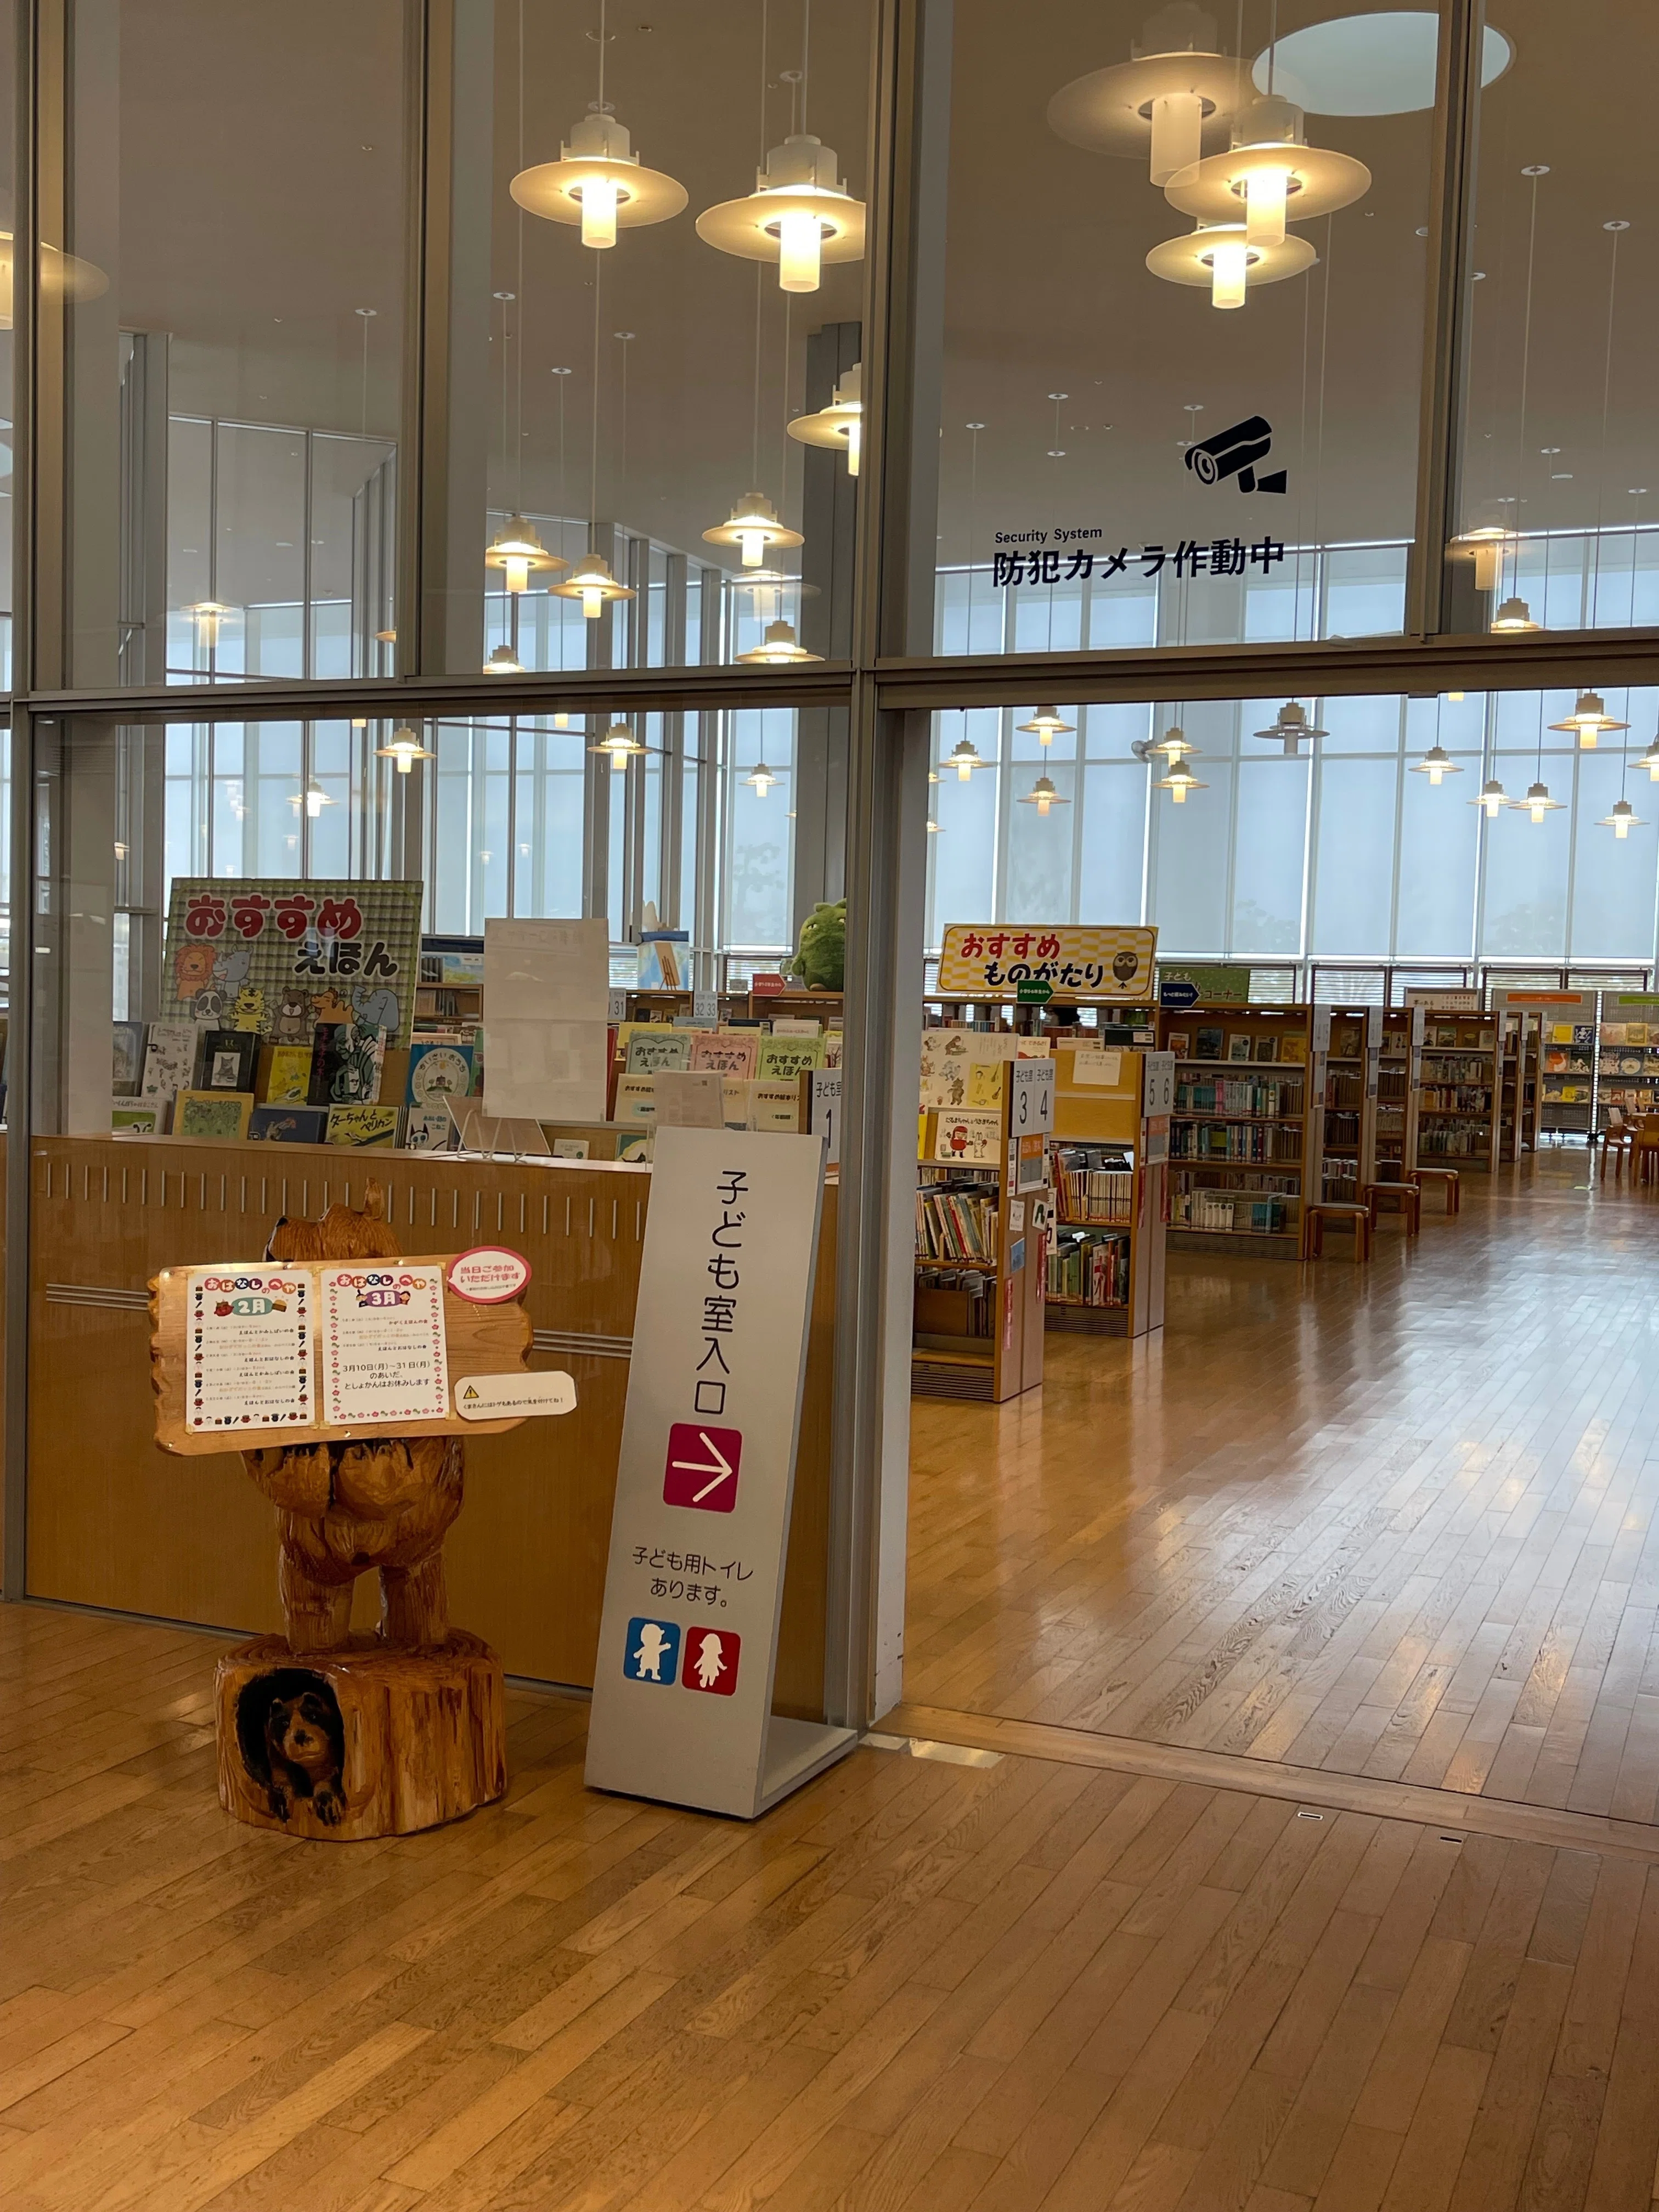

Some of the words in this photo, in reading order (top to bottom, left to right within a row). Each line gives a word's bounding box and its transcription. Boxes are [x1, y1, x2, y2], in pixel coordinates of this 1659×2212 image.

[995, 530, 1048, 544] Security
[1053, 527, 1103, 543] System
[992, 536, 1284, 587] 防犯カメラ作動中
[185, 894, 362, 939] おすすめ
[961, 933, 1060, 959] おすすめ
[294, 941, 398, 977] えほん
[984, 961, 1104, 988] ものがたり
[1164, 972, 1192, 981] 子ども
[614, 1001, 624, 1014] 31
[695, 1003, 704, 1016] 32
[707, 1003, 716, 1016] 33
[635, 1046, 679, 1057] おすすめ
[701, 1050, 747, 1062] おすすめ
[766, 1054, 812, 1065] おすすめ
[640, 1057, 670, 1067] えほん
[706, 1060, 739, 1070] えほん
[1149, 1078, 1155, 1106] 5
[1164, 1077, 1170, 1105] 6
[1019, 1091, 1027, 1124] 3
[1040, 1090, 1048, 1121] 4
[330, 1109, 377, 1128] ターちゃんと
[360, 1118, 393, 1131] ペリカン
[826, 1108, 832, 1149] 1
[460, 1264, 514, 1274] 当日ご参加
[337, 1274, 426, 1290] おはなしのへや
[460, 1272, 520, 1283] いただけます
[205, 1278, 296, 1294] おはなしのへや
[694, 1170, 749, 1414] 子ども室入口
[371, 1291, 396, 1305] 3月
[238, 1299, 266, 1314] 2月
[345, 1379, 430, 1390] としょかんはお休みします
[633, 1546, 754, 1581] 子ども用トイレ
[651, 1577, 727, 1607] あります。
